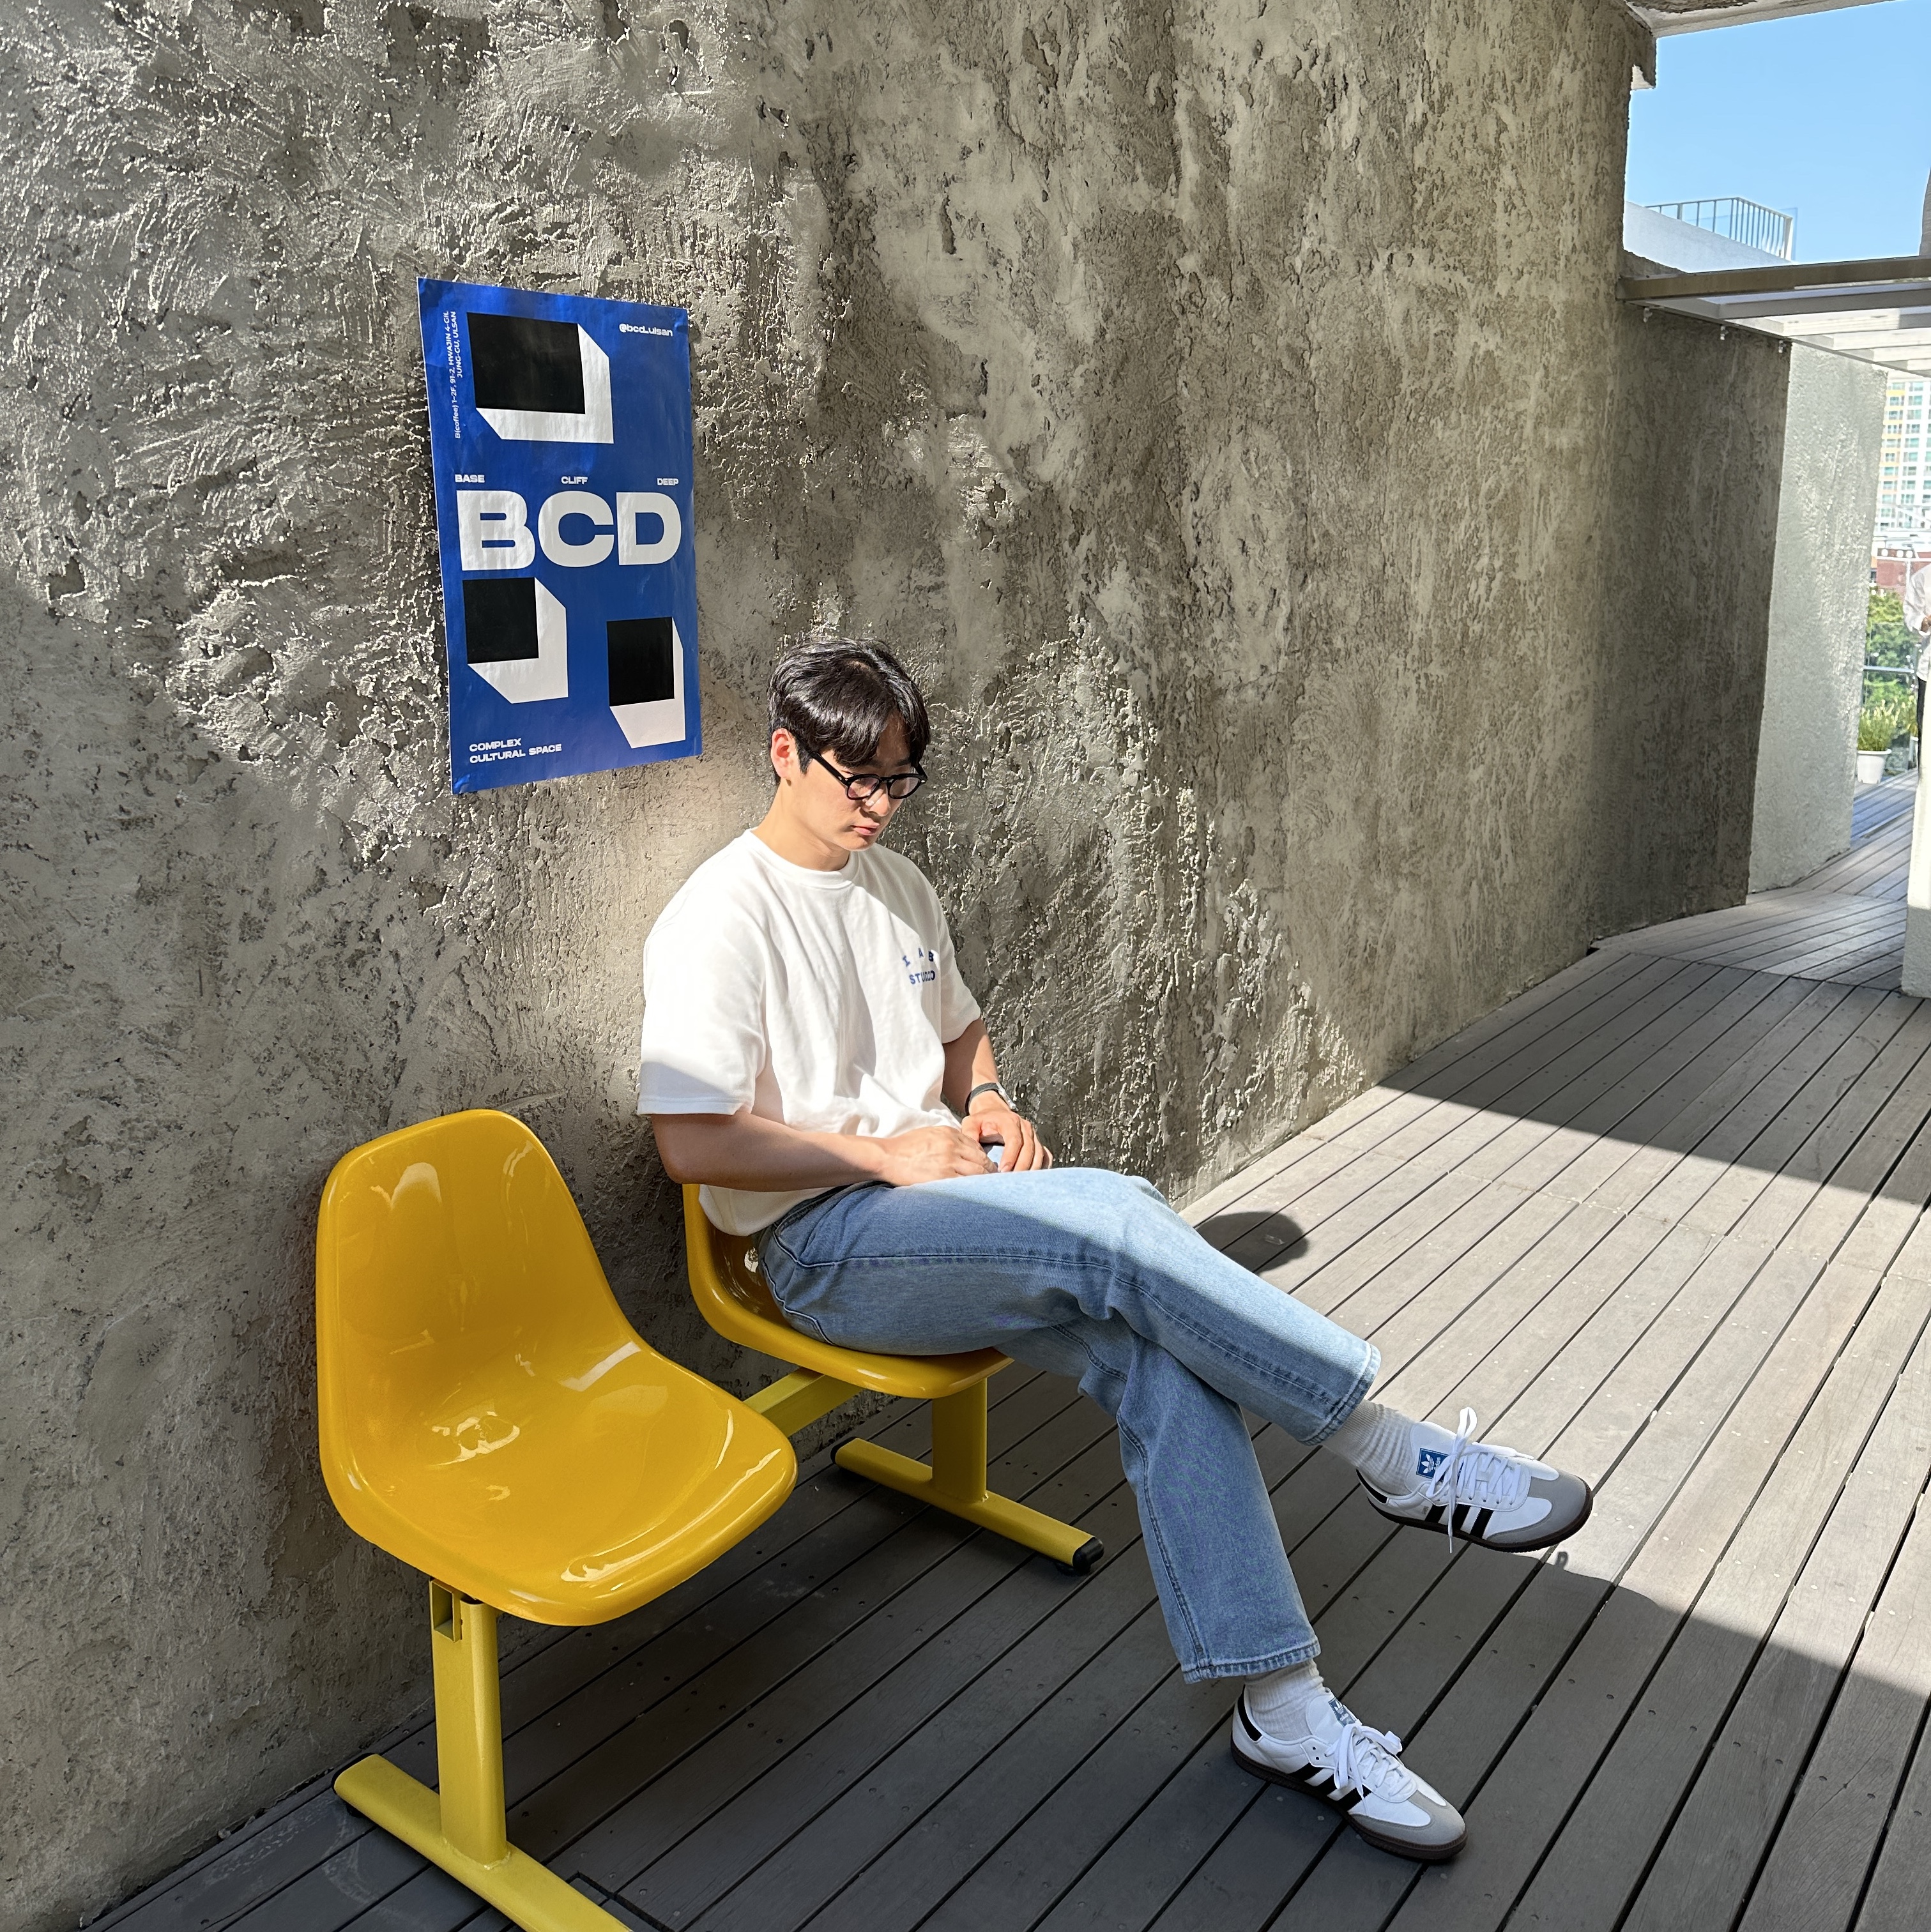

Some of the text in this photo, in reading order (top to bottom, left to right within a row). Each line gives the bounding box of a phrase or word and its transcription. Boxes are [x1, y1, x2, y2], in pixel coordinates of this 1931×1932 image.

[619, 323, 673, 337] @bcd_ulsan
[445, 333, 454, 365] HWAJIN
[450, 311, 463, 378] JUNG-GU, ULSAN
[455, 474, 485, 483] BASE
[561, 476, 588, 485] CLIFF
[456, 490, 682, 571] BCD
[469, 738, 522, 752] COMPLEX
[469, 743, 562, 764] CULTURAL SPACE
[909, 970, 936, 984] STUDIO
